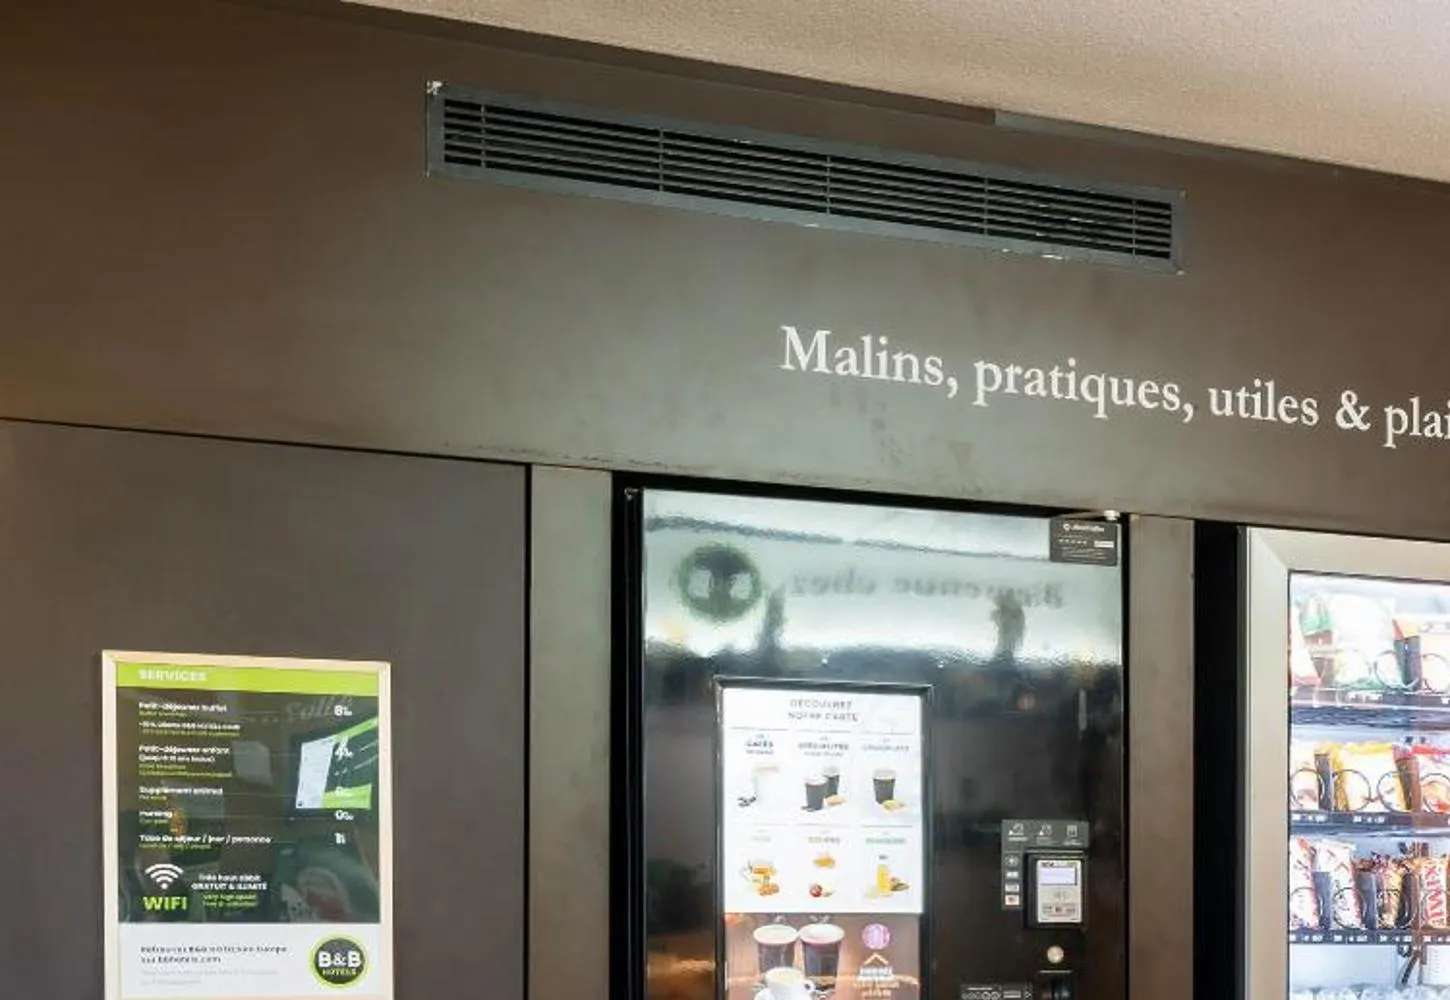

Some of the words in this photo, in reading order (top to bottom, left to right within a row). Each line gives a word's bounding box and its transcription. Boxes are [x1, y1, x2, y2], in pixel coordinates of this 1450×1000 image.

[779, 325, 960, 399] Malins,
[972, 356, 1194, 422] pratiques,
[1207, 378, 1320, 427] utiles
[1334, 389, 1372, 432] &
[143, 896, 188, 911] WIFI
[318, 950, 361, 968] B&B
